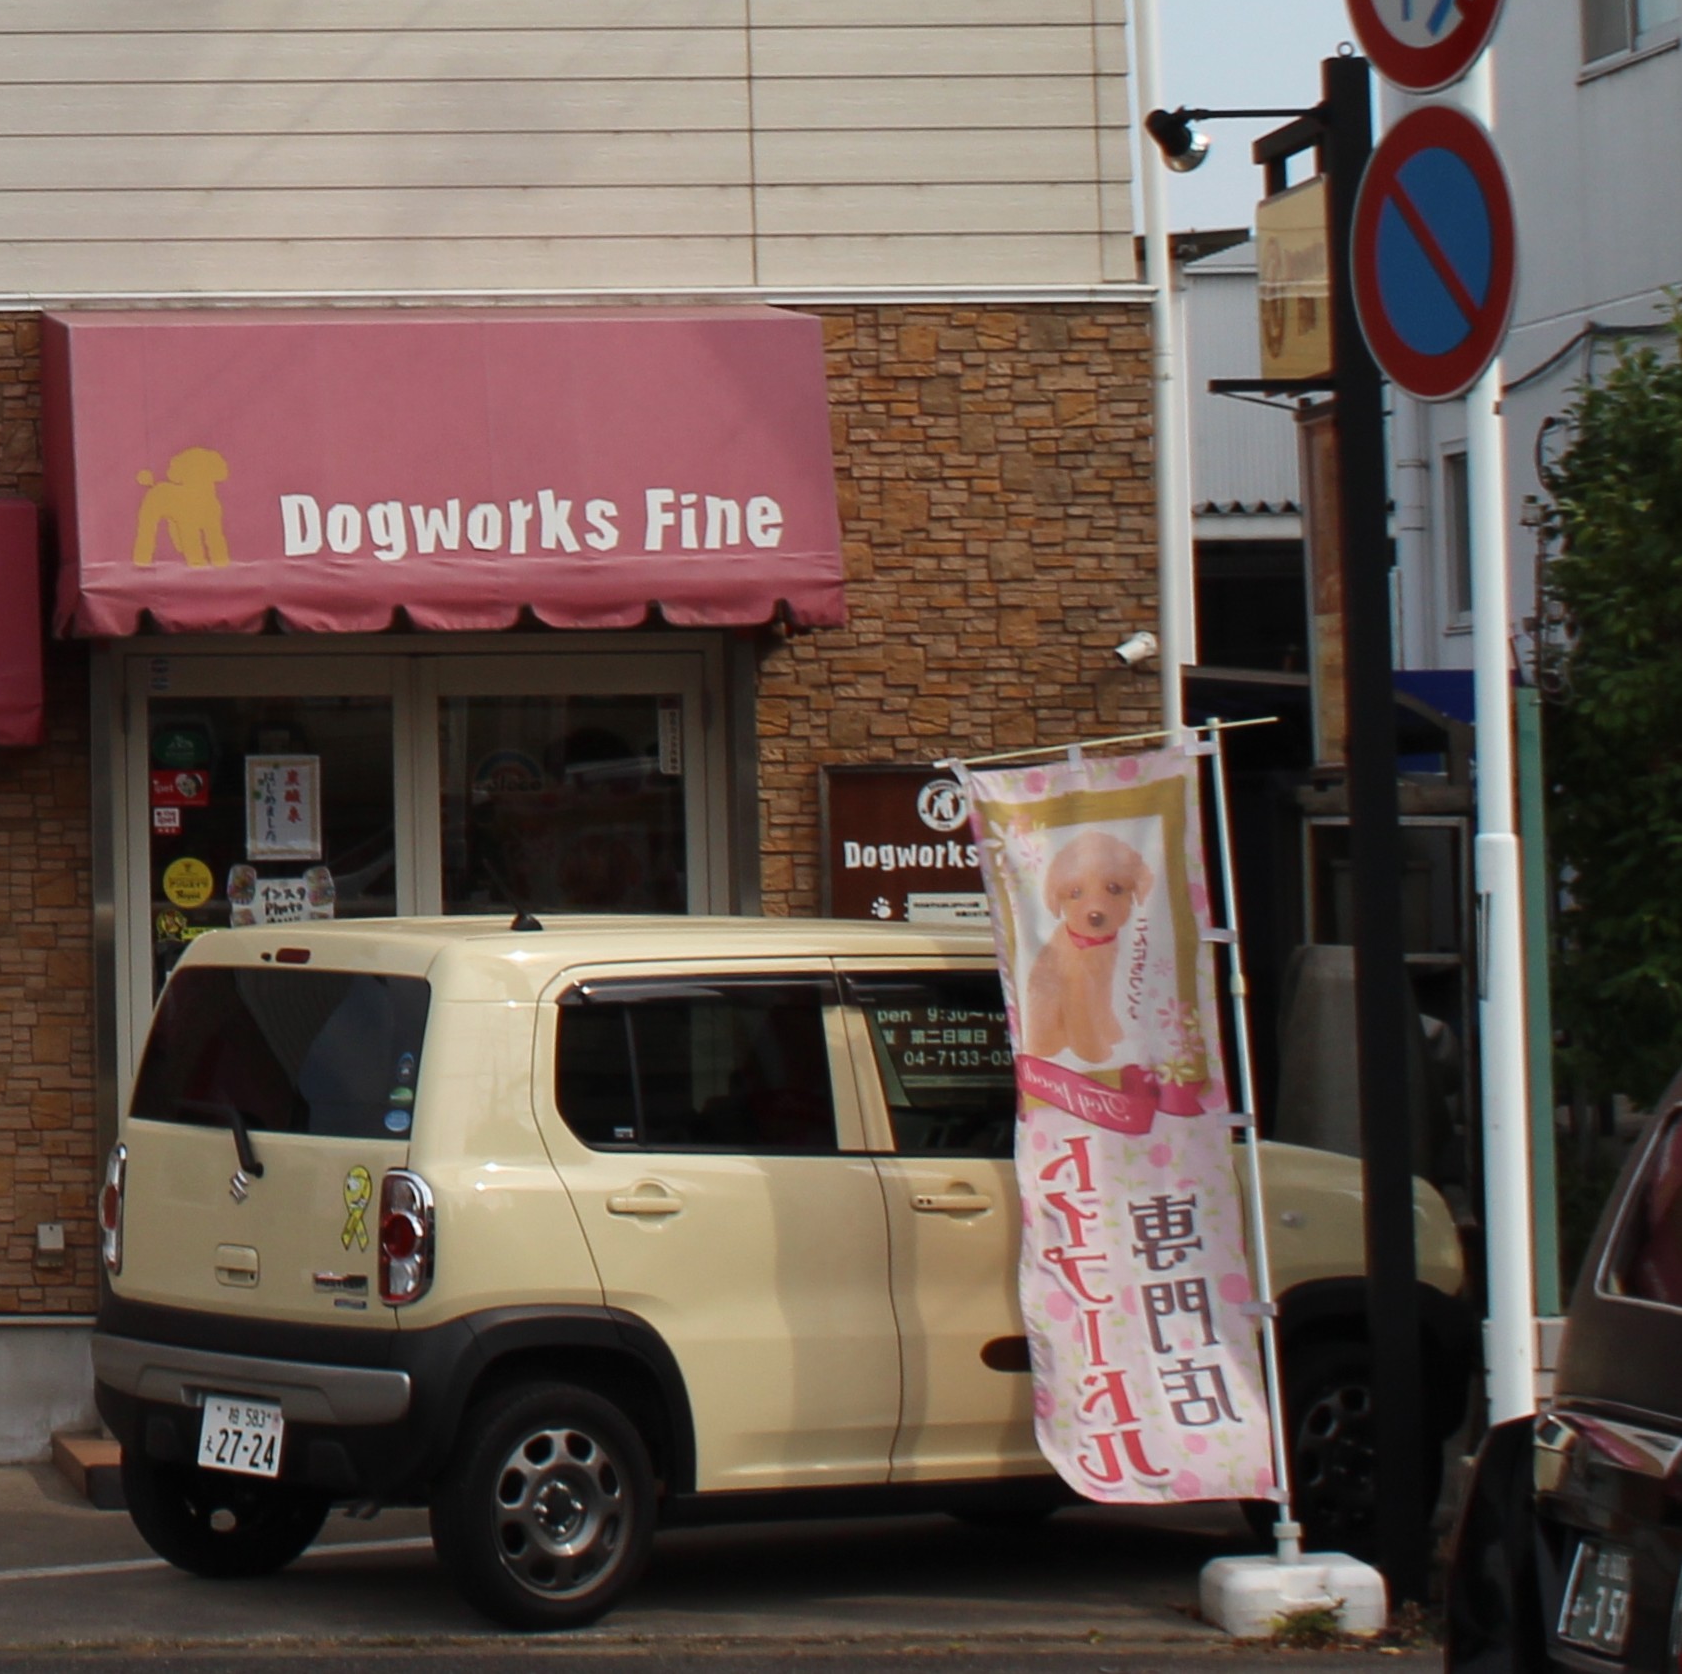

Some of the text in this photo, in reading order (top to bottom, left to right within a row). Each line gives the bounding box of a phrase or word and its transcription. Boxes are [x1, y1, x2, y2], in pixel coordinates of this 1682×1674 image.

[279, 487, 784, 562] Dogworks Fine
[843, 839, 980, 872] Dogworks
[216, 1429, 275, 1469] 27-24
